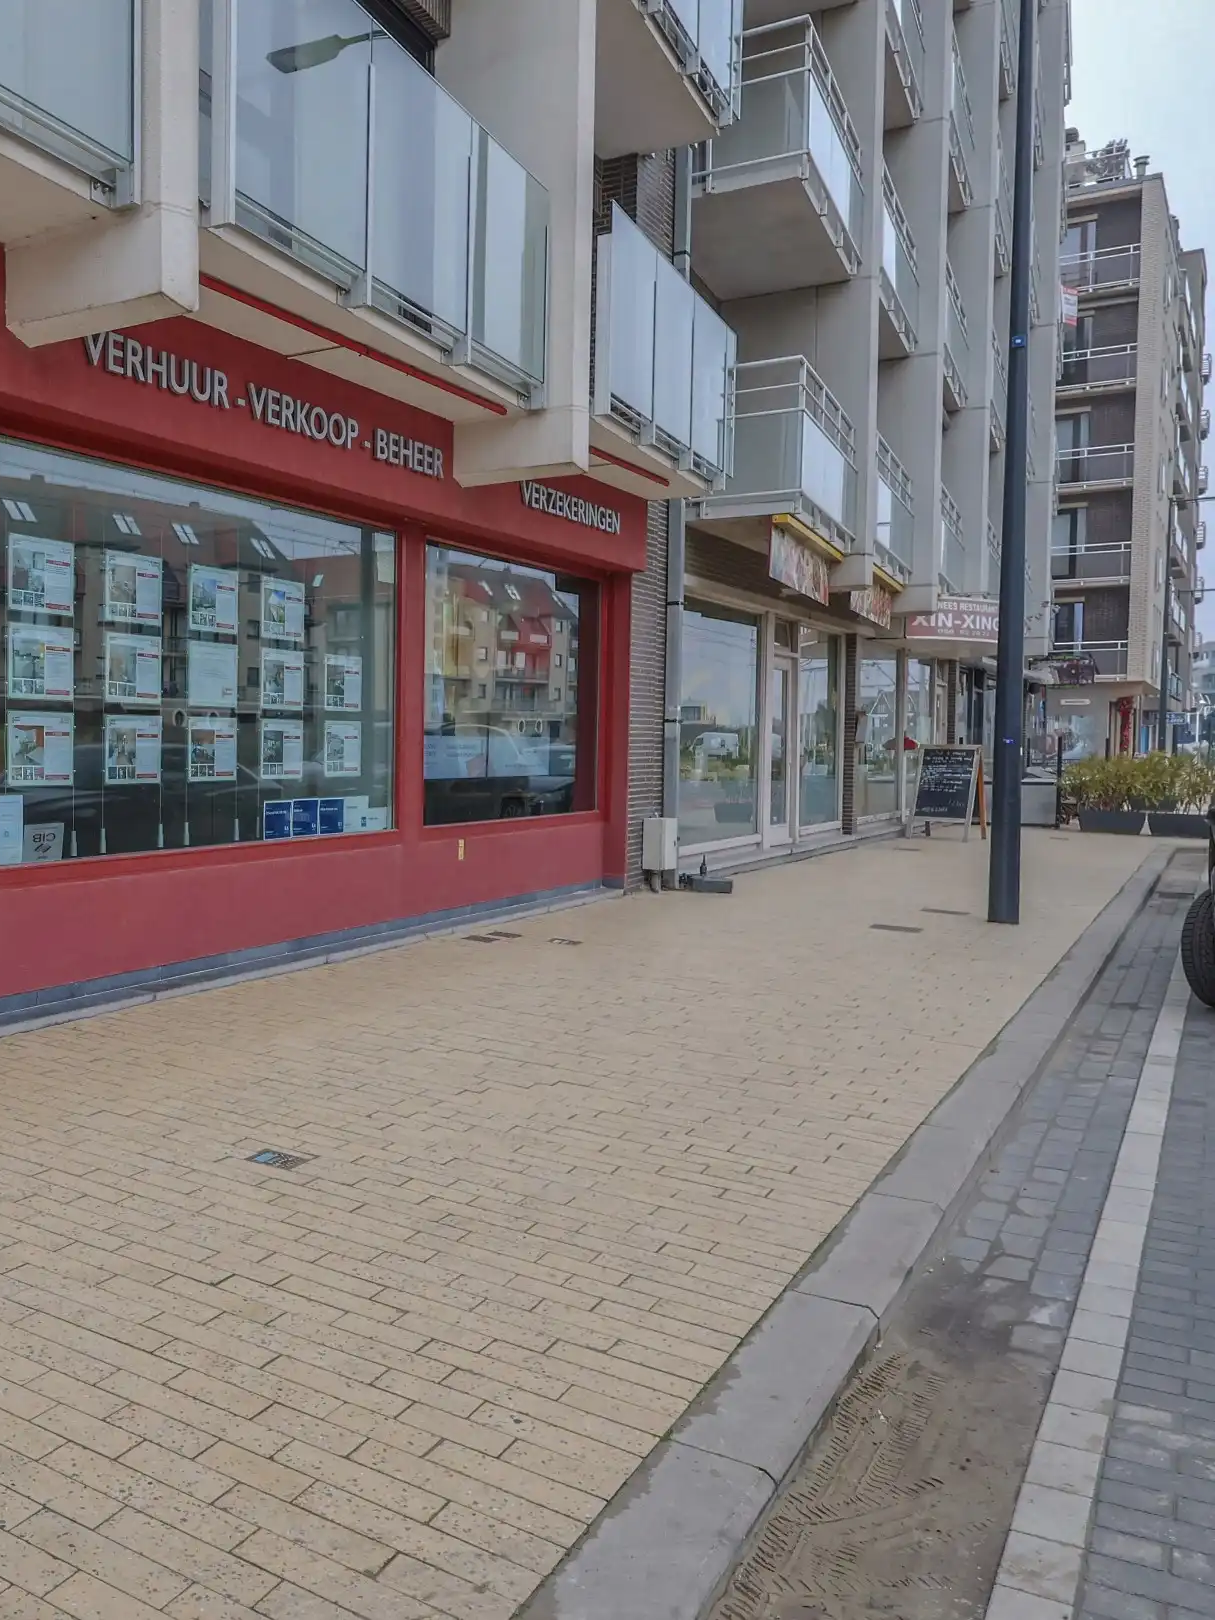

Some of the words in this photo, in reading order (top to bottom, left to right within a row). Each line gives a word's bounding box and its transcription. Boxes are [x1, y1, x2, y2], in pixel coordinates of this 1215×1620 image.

[84, 333, 230, 409] VERHUUR
[247, 381, 359, 450] VERKOOP
[372, 428, 444, 479] BEHEER
[520, 481, 621, 536] VERZEKERINGEN
[937, 601, 958, 610] NEES
